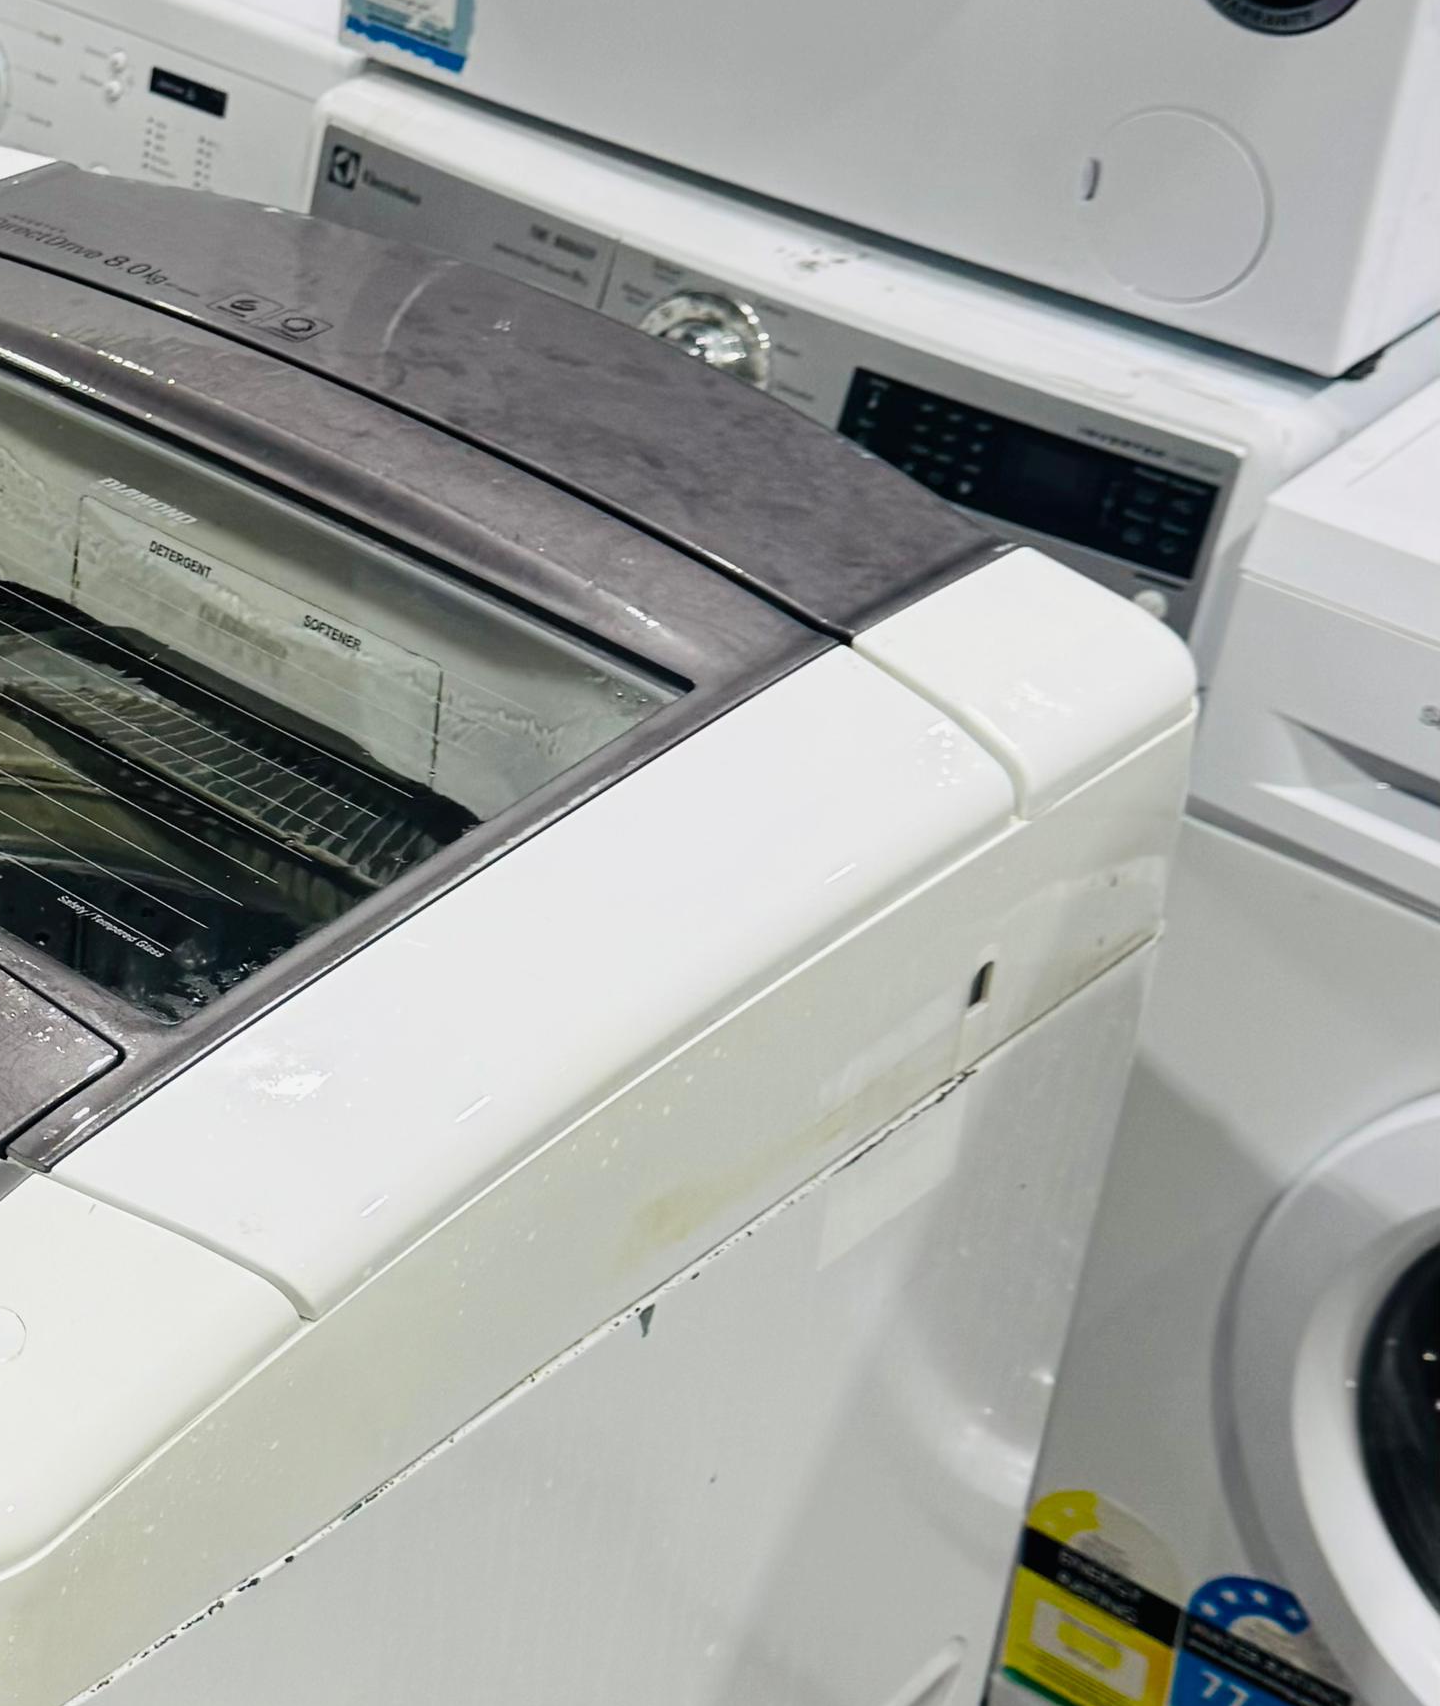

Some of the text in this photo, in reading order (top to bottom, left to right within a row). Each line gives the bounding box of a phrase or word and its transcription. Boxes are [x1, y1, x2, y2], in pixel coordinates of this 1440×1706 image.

[98, 477, 199, 526] DIAMOND
[148, 539, 212, 580] DETERGENT
[303, 613, 363, 652] SOFTENER
